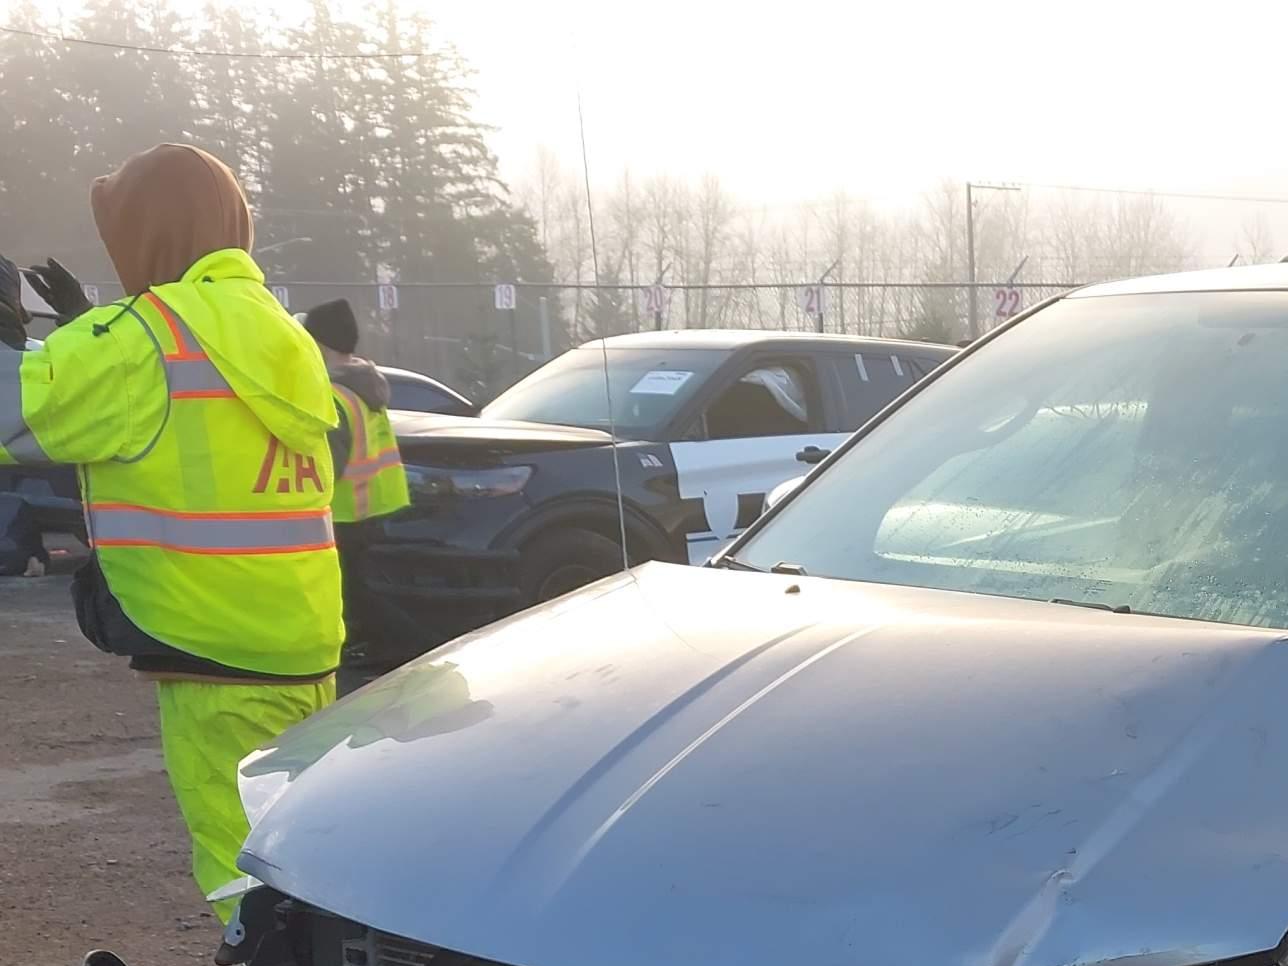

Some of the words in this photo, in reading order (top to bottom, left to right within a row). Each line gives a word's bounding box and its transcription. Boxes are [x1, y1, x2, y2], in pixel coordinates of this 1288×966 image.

[499, 286, 513, 307] 19
[645, 287, 663, 312] 20
[804, 287, 821, 313] 21
[995, 290, 1019, 317] 22
